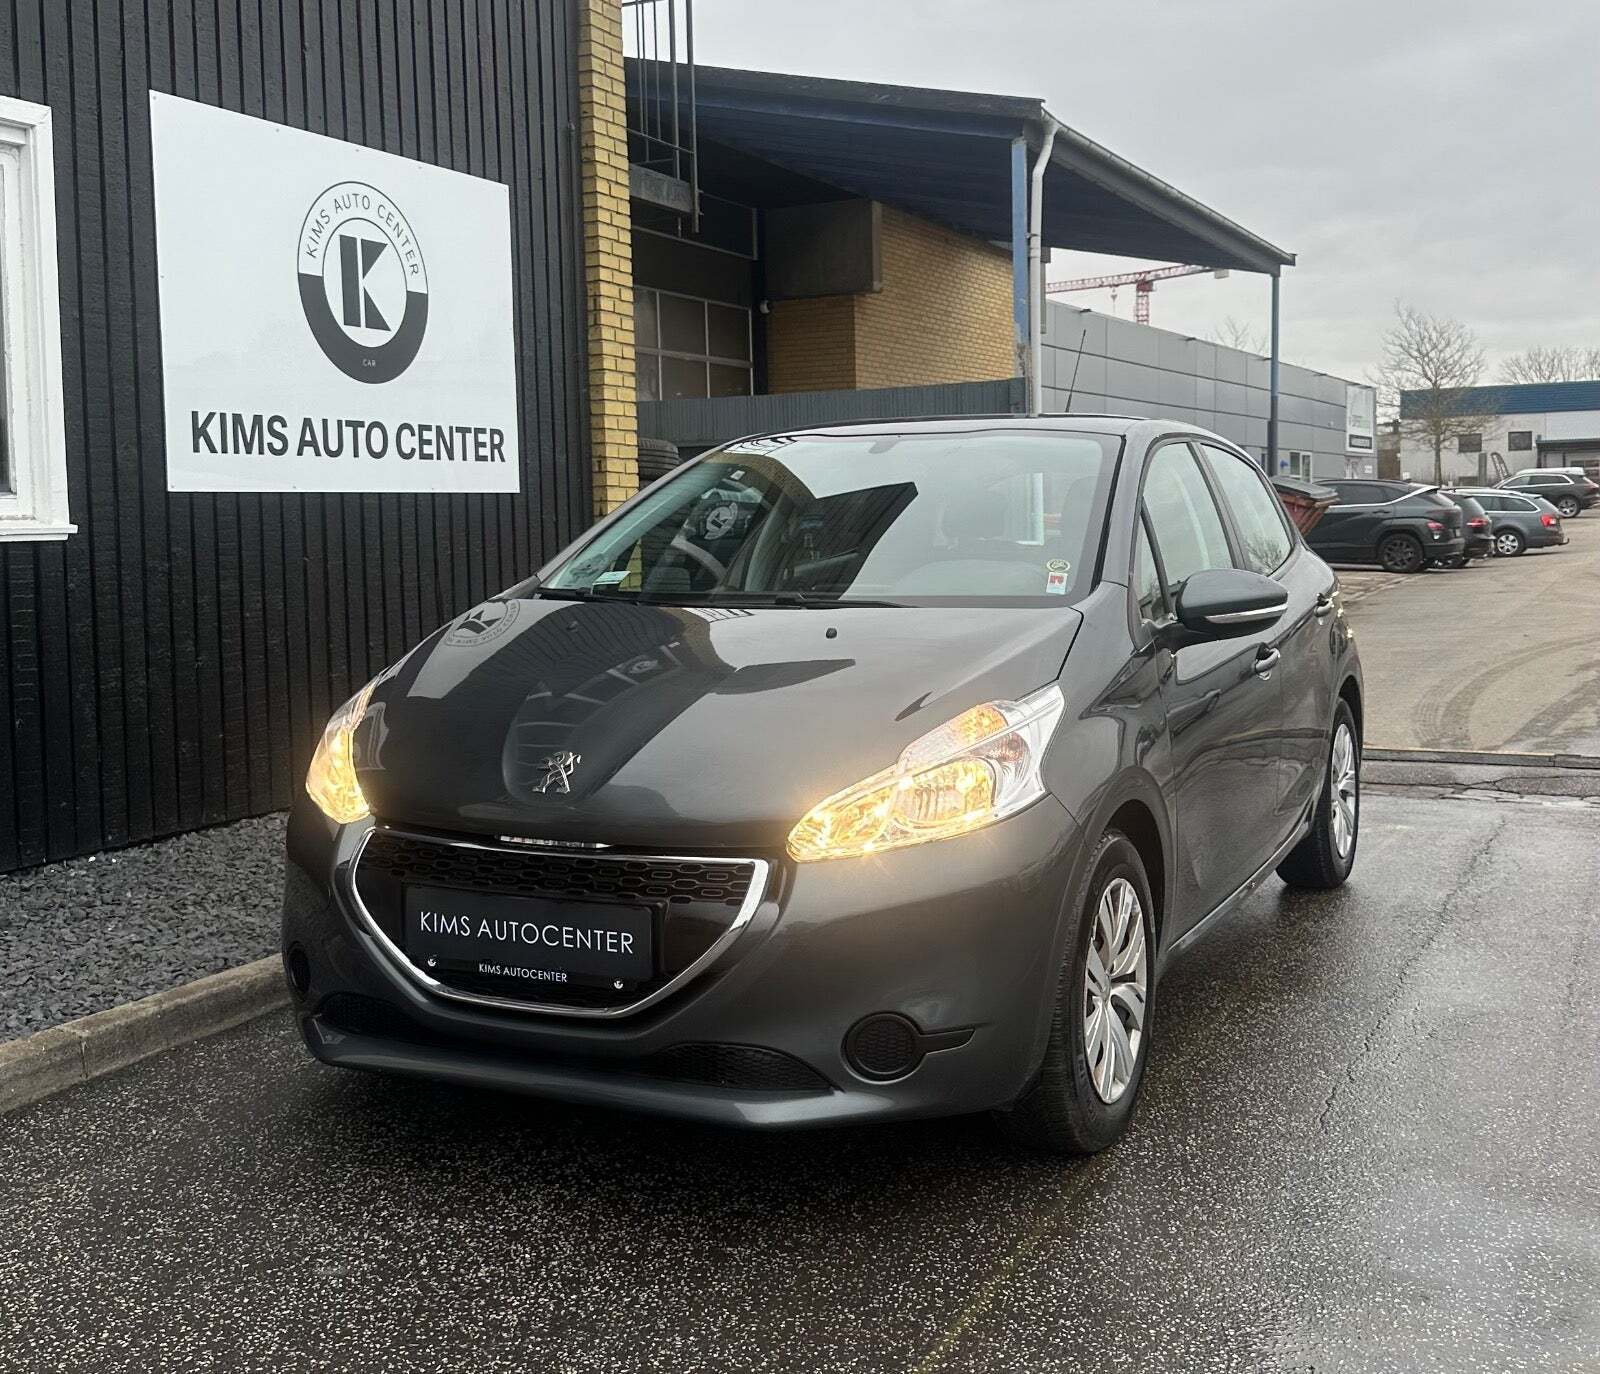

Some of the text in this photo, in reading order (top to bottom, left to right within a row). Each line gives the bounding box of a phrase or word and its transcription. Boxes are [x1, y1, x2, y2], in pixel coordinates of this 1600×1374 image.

[307, 193, 418, 276] KIMS AUTO CENTER
[339, 234, 391, 332] K
[191, 410, 505, 463] KIMS AUTO CENTER
[420, 911, 633, 954] KIMS AUTOCENTER
[478, 963, 567, 983] KIMS AUTOCENTER
